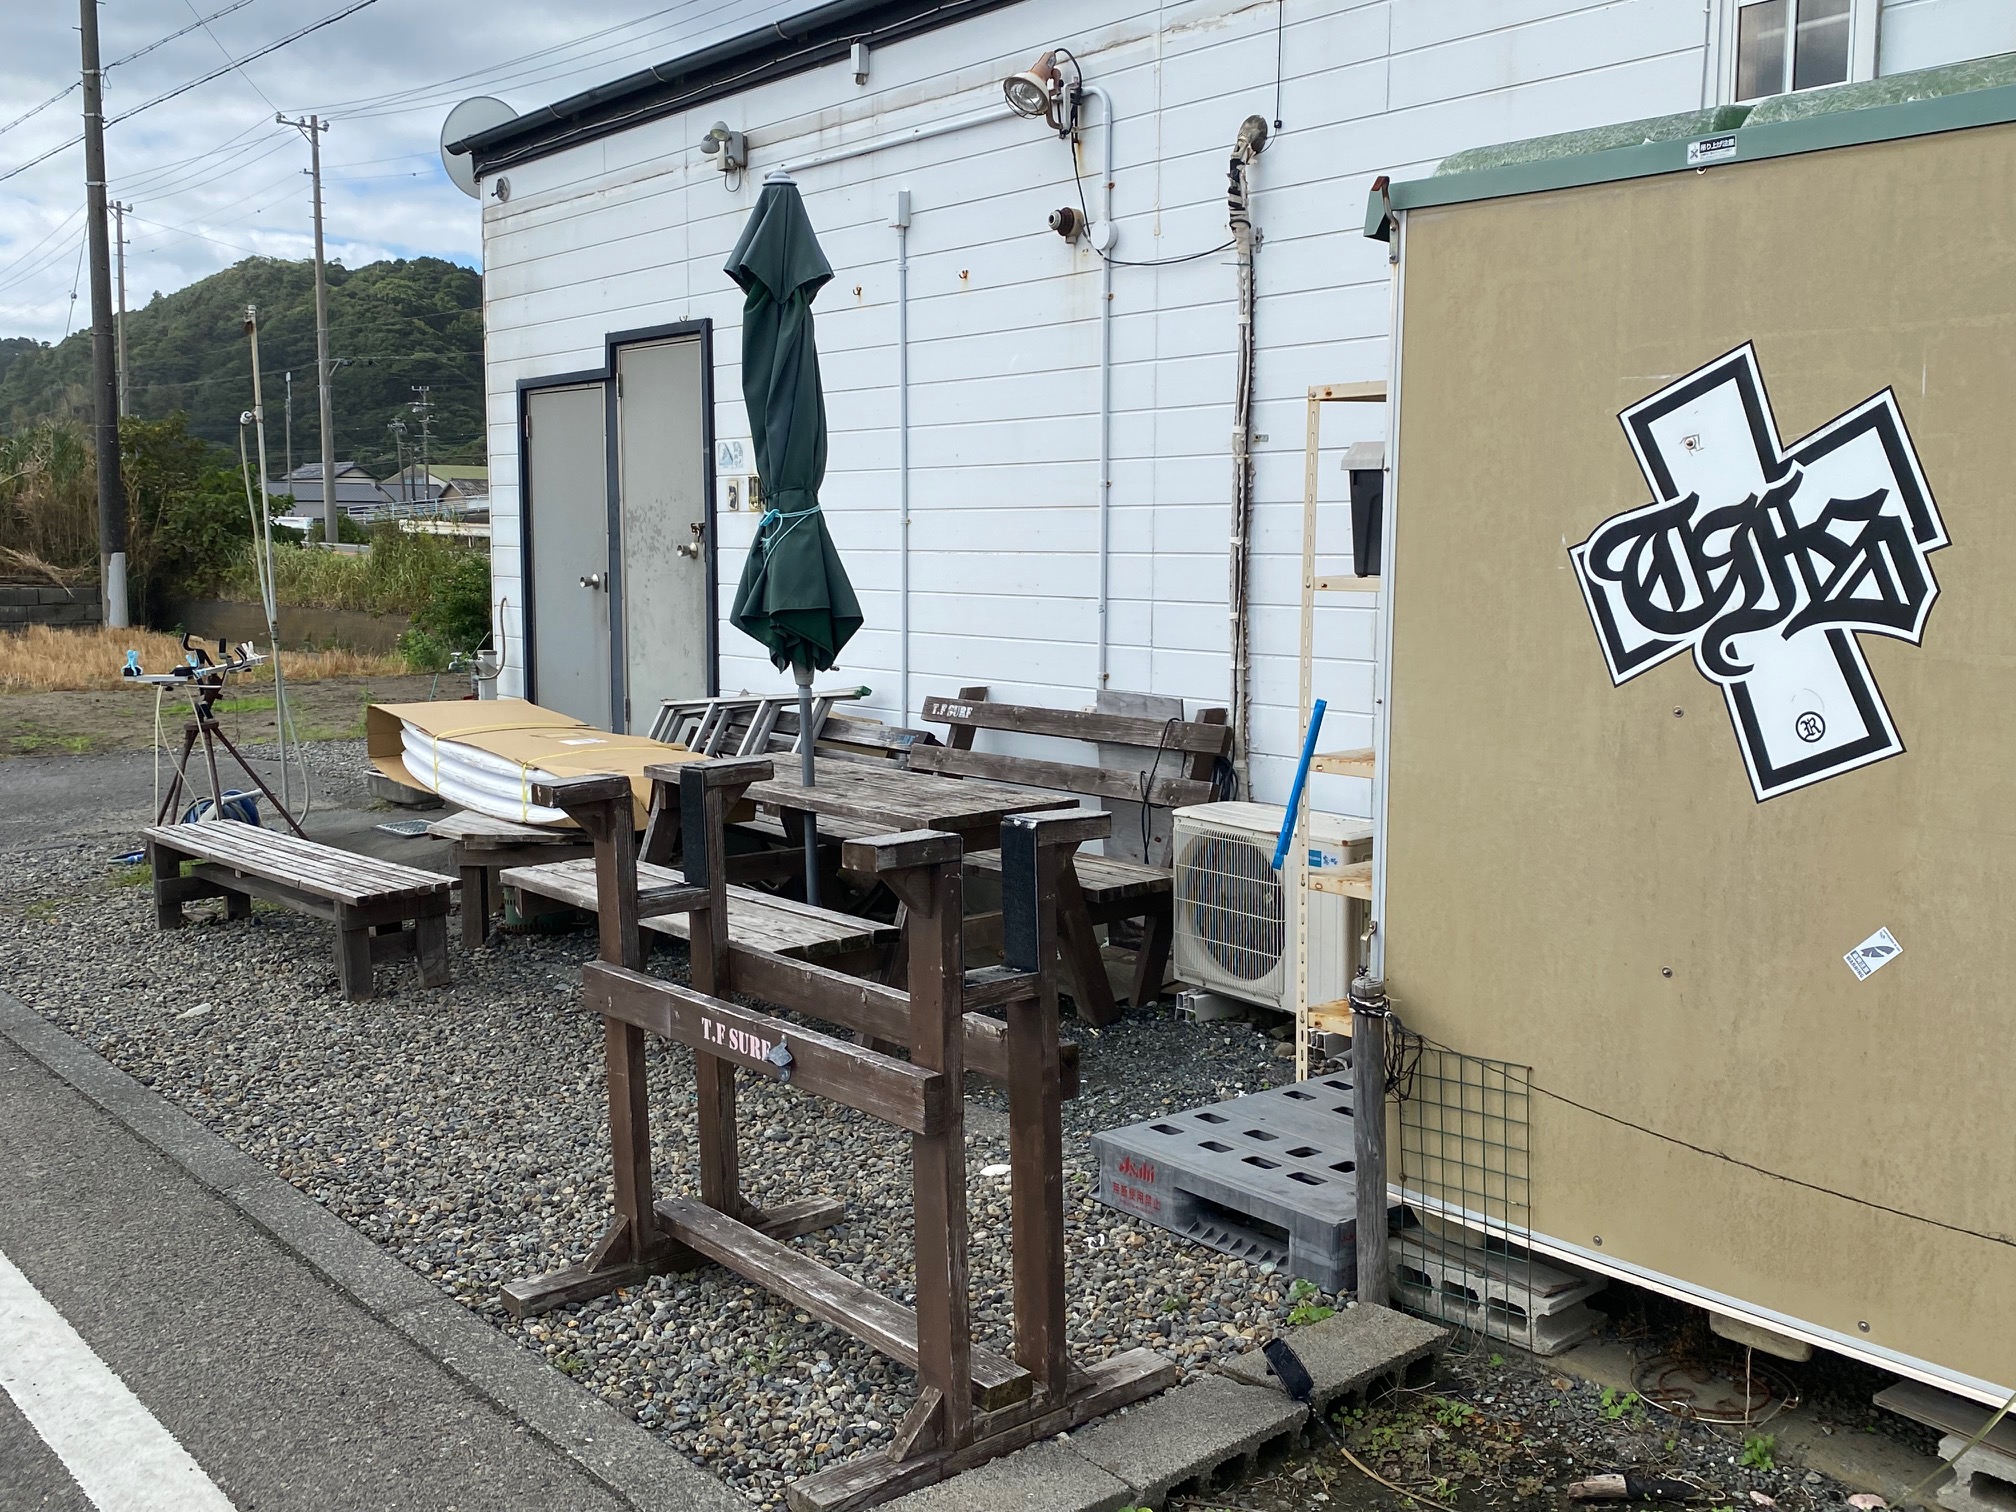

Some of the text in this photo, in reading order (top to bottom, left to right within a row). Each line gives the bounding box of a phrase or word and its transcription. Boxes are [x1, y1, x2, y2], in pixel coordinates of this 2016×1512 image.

[932, 703, 974, 718] T.F SURF
[701, 1017, 726, 1045] T.F
[1119, 1155, 1155, 1184] Asahi
